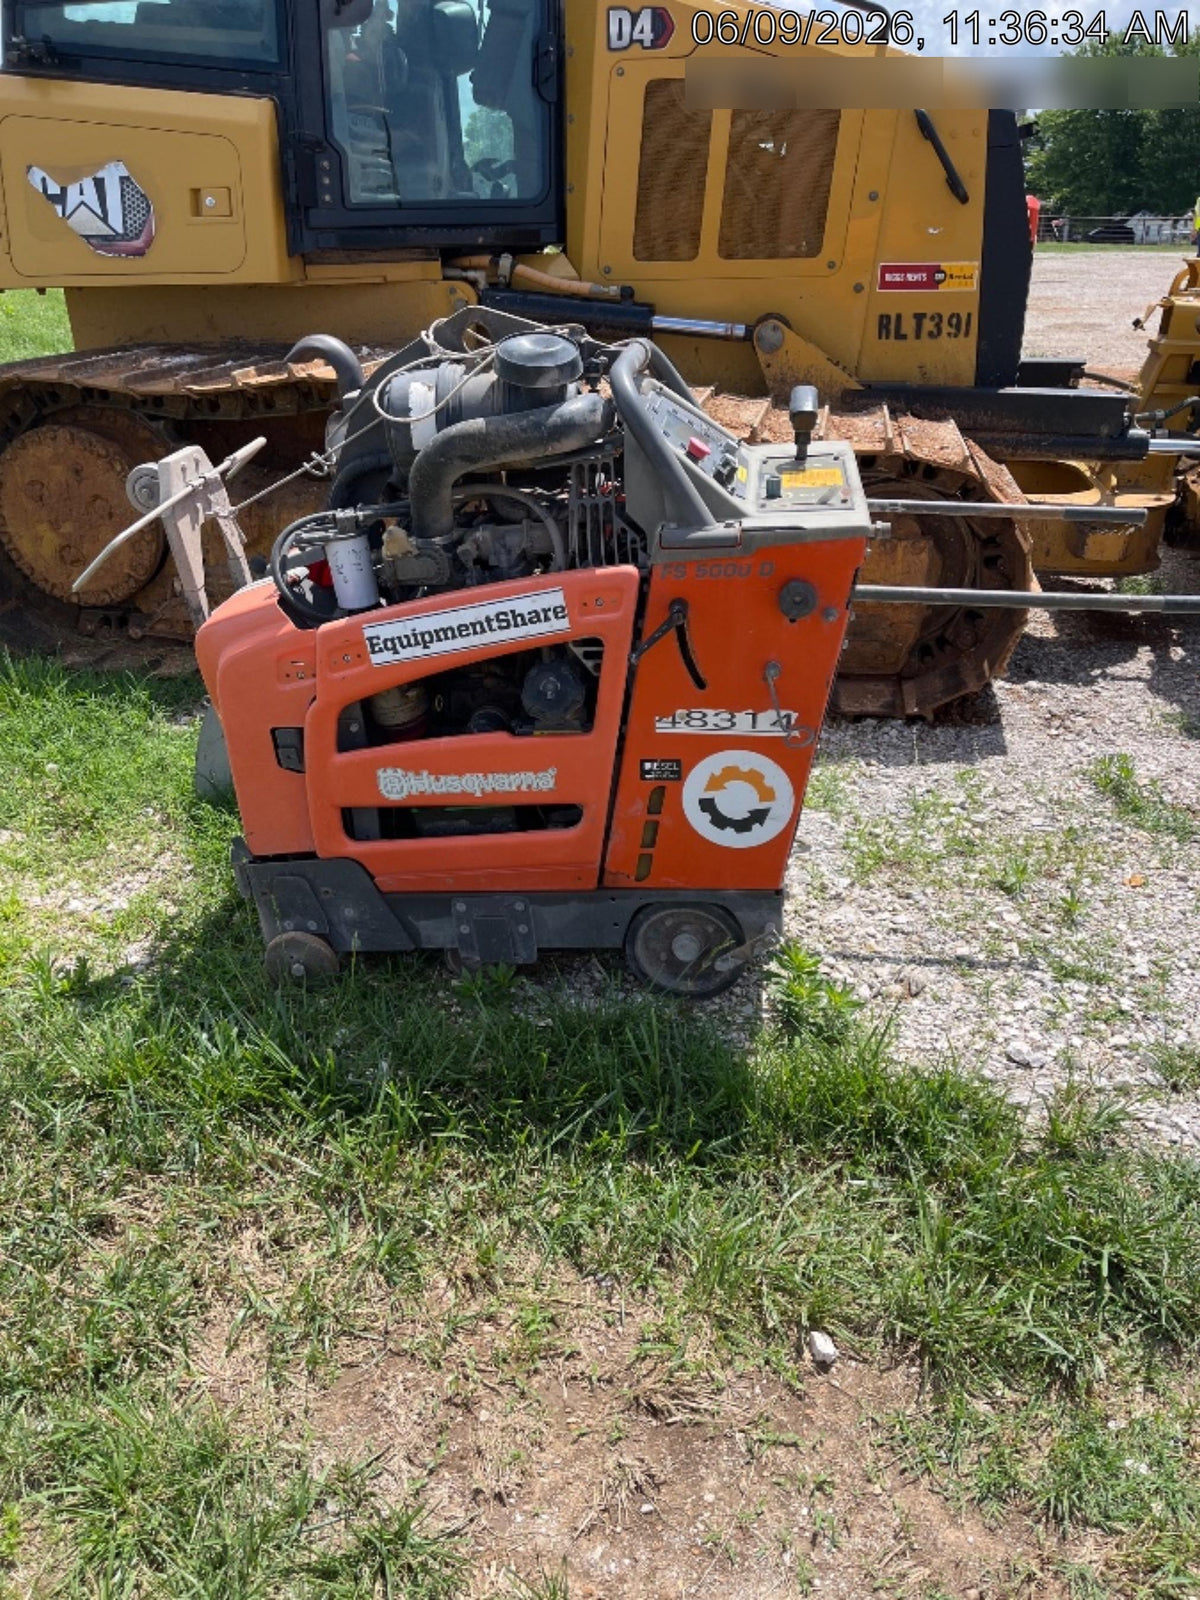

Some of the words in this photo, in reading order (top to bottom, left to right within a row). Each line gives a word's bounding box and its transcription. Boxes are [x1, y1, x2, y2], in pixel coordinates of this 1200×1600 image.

[608, 8, 655, 50] D4
[878, 312, 972, 340] RLT391
[661, 562, 687, 579] FS
[696, 561, 752, 578] 5000
[758, 561, 775, 577] D
[366, 604, 567, 654] EquipmentShare
[406, 768, 556, 797] Husqvarna
